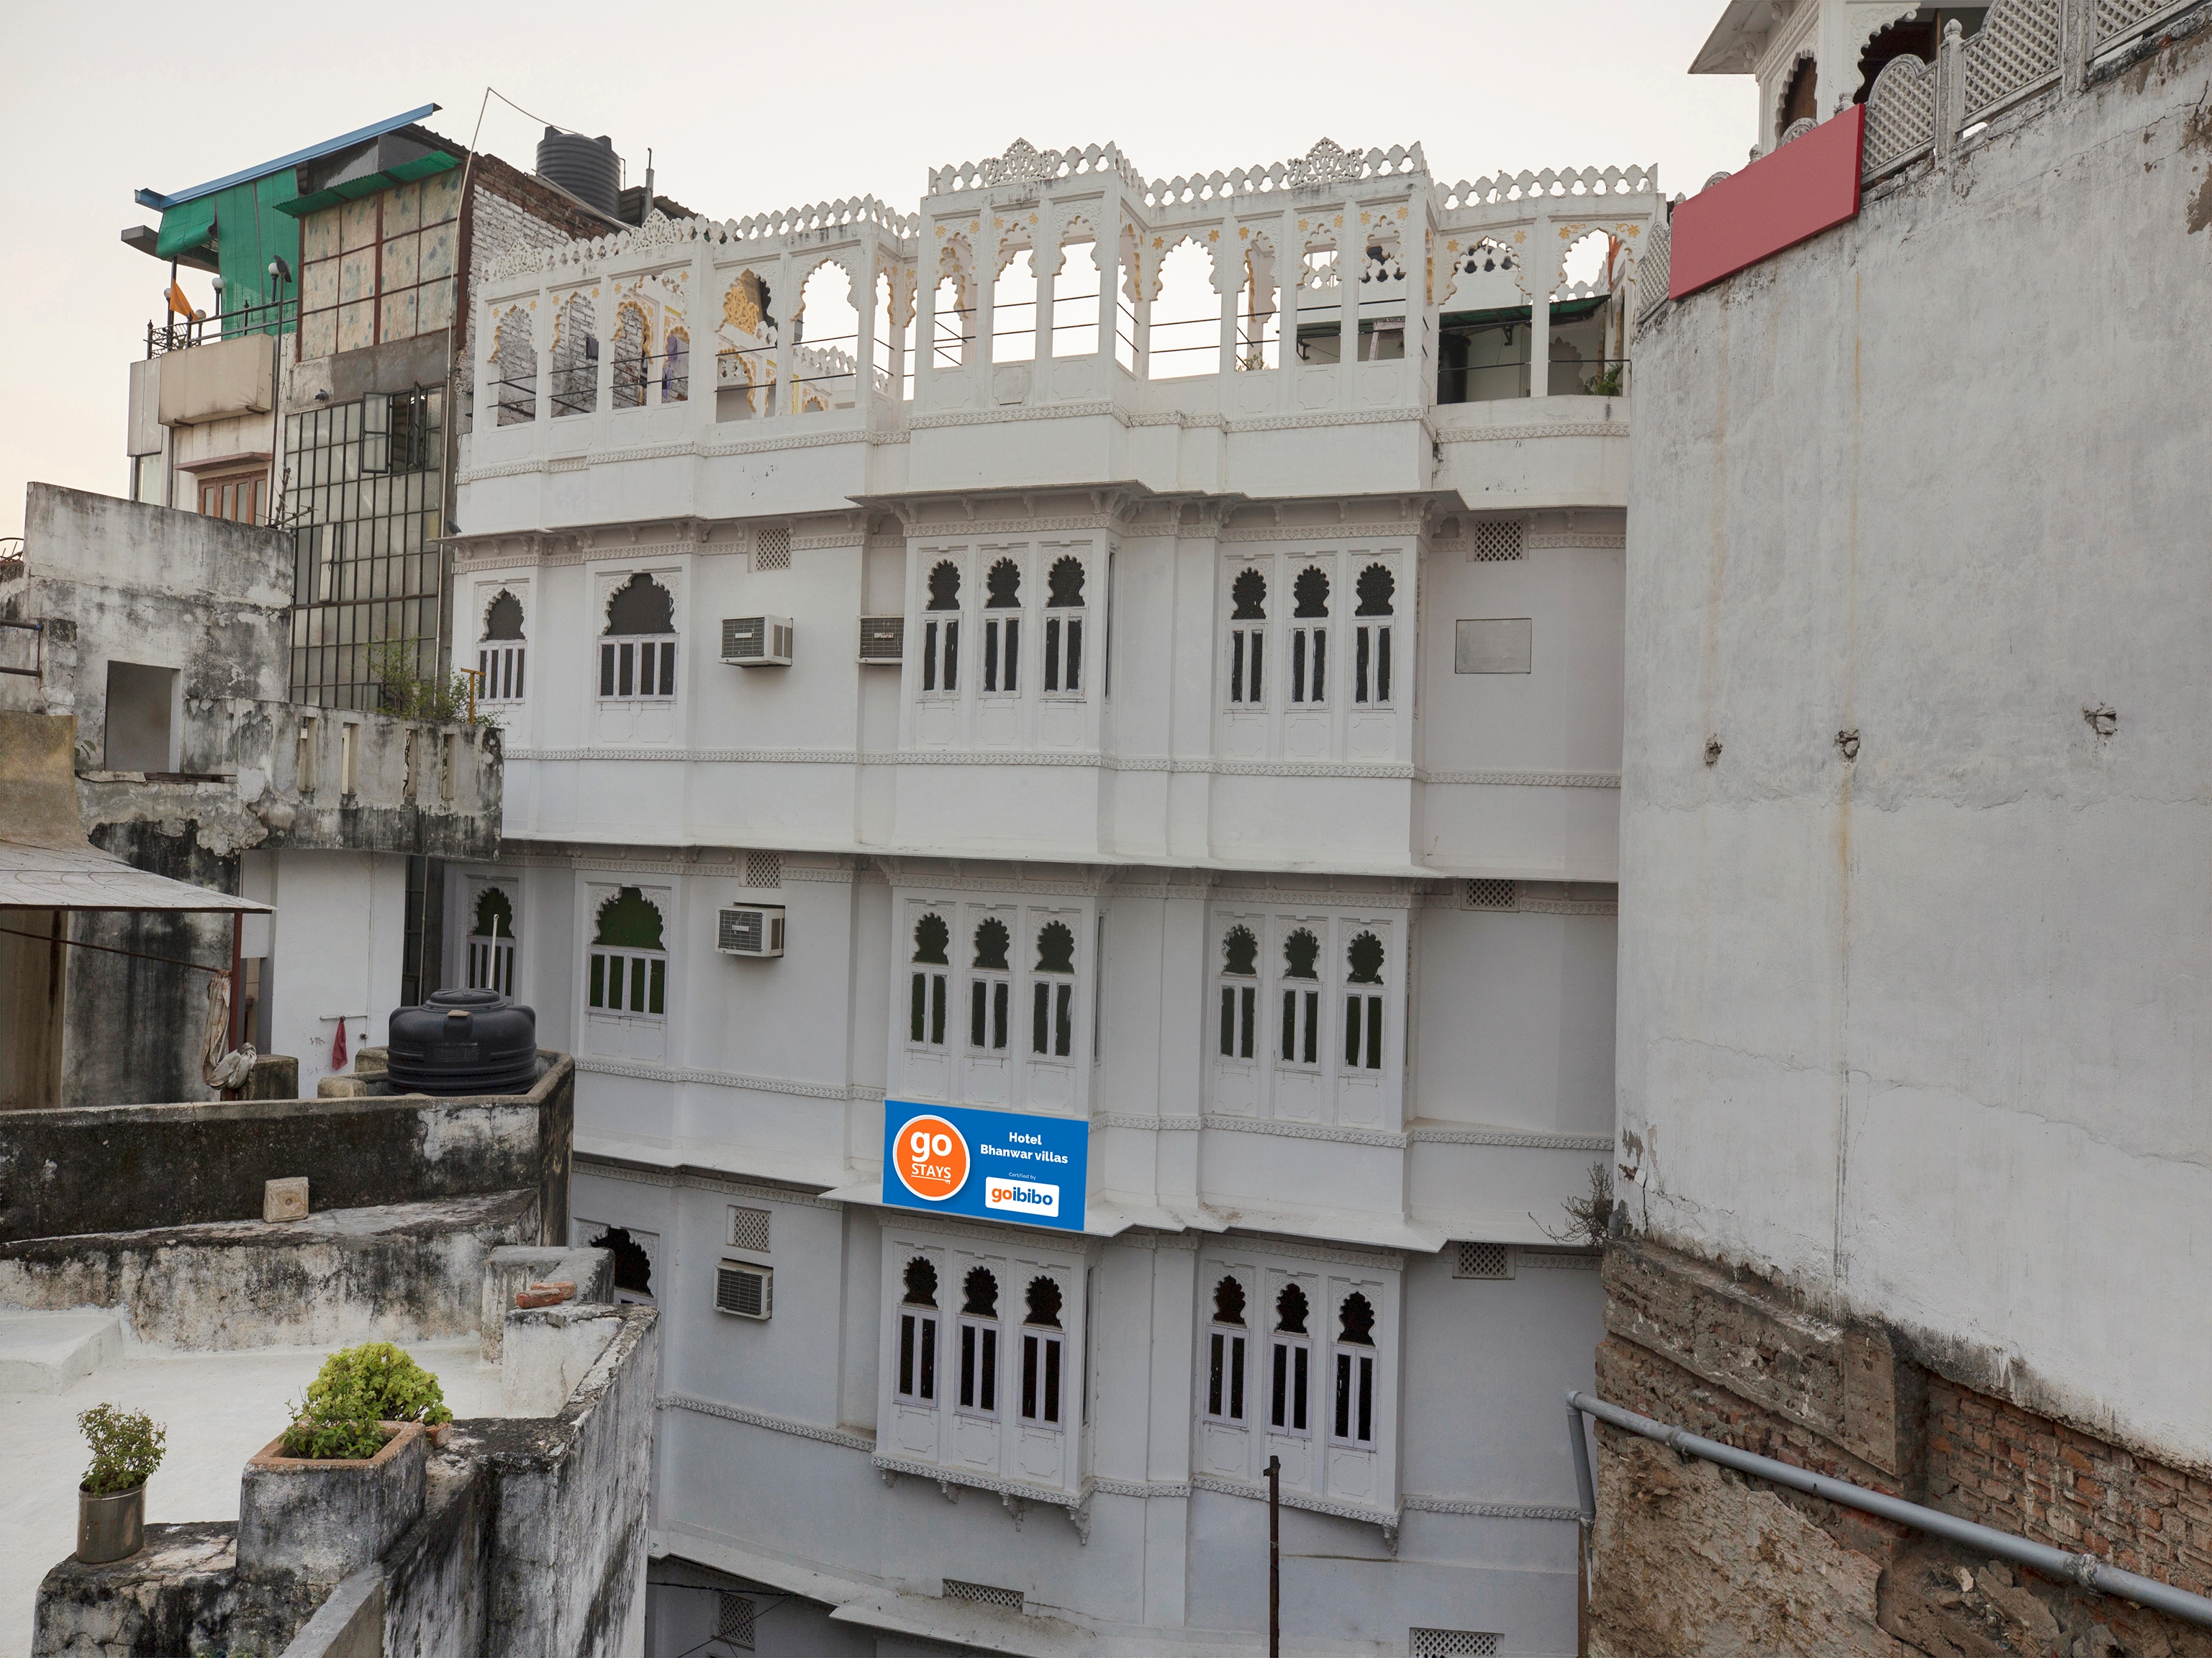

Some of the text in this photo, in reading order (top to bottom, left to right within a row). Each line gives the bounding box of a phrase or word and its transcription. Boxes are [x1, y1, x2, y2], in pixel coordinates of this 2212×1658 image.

[910, 1131, 952, 1162] go
[1009, 1132, 1042, 1145] Hotel
[980, 1143, 1069, 1164] Bhanwar villas
[911, 1162, 951, 1179] STAYS
[992, 1187, 1053, 1205] goibibo
